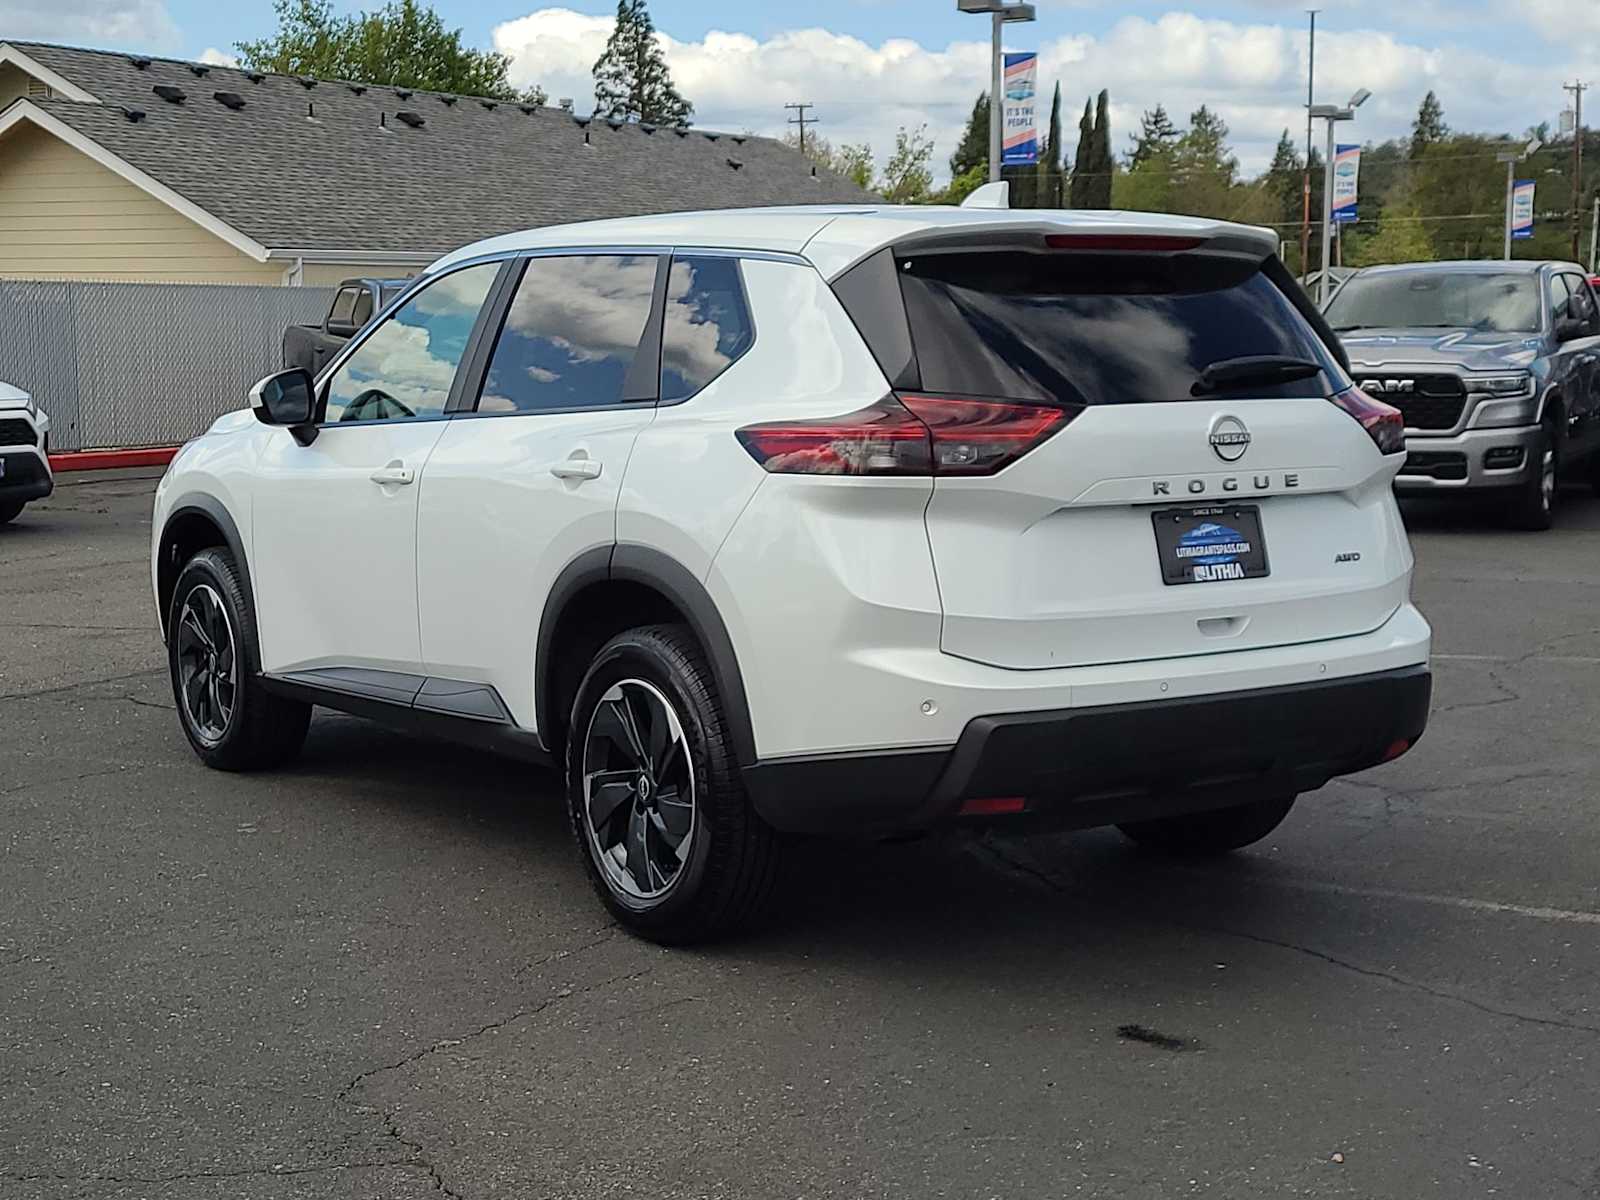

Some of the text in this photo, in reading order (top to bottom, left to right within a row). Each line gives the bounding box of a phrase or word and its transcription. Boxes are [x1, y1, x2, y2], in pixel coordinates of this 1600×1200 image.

[1352, 380, 1414, 392] AM
[1210, 433, 1251, 445] NISSAN
[1152, 474, 1299, 495] ROGUE
[1204, 562, 1245, 580] LITHIA
